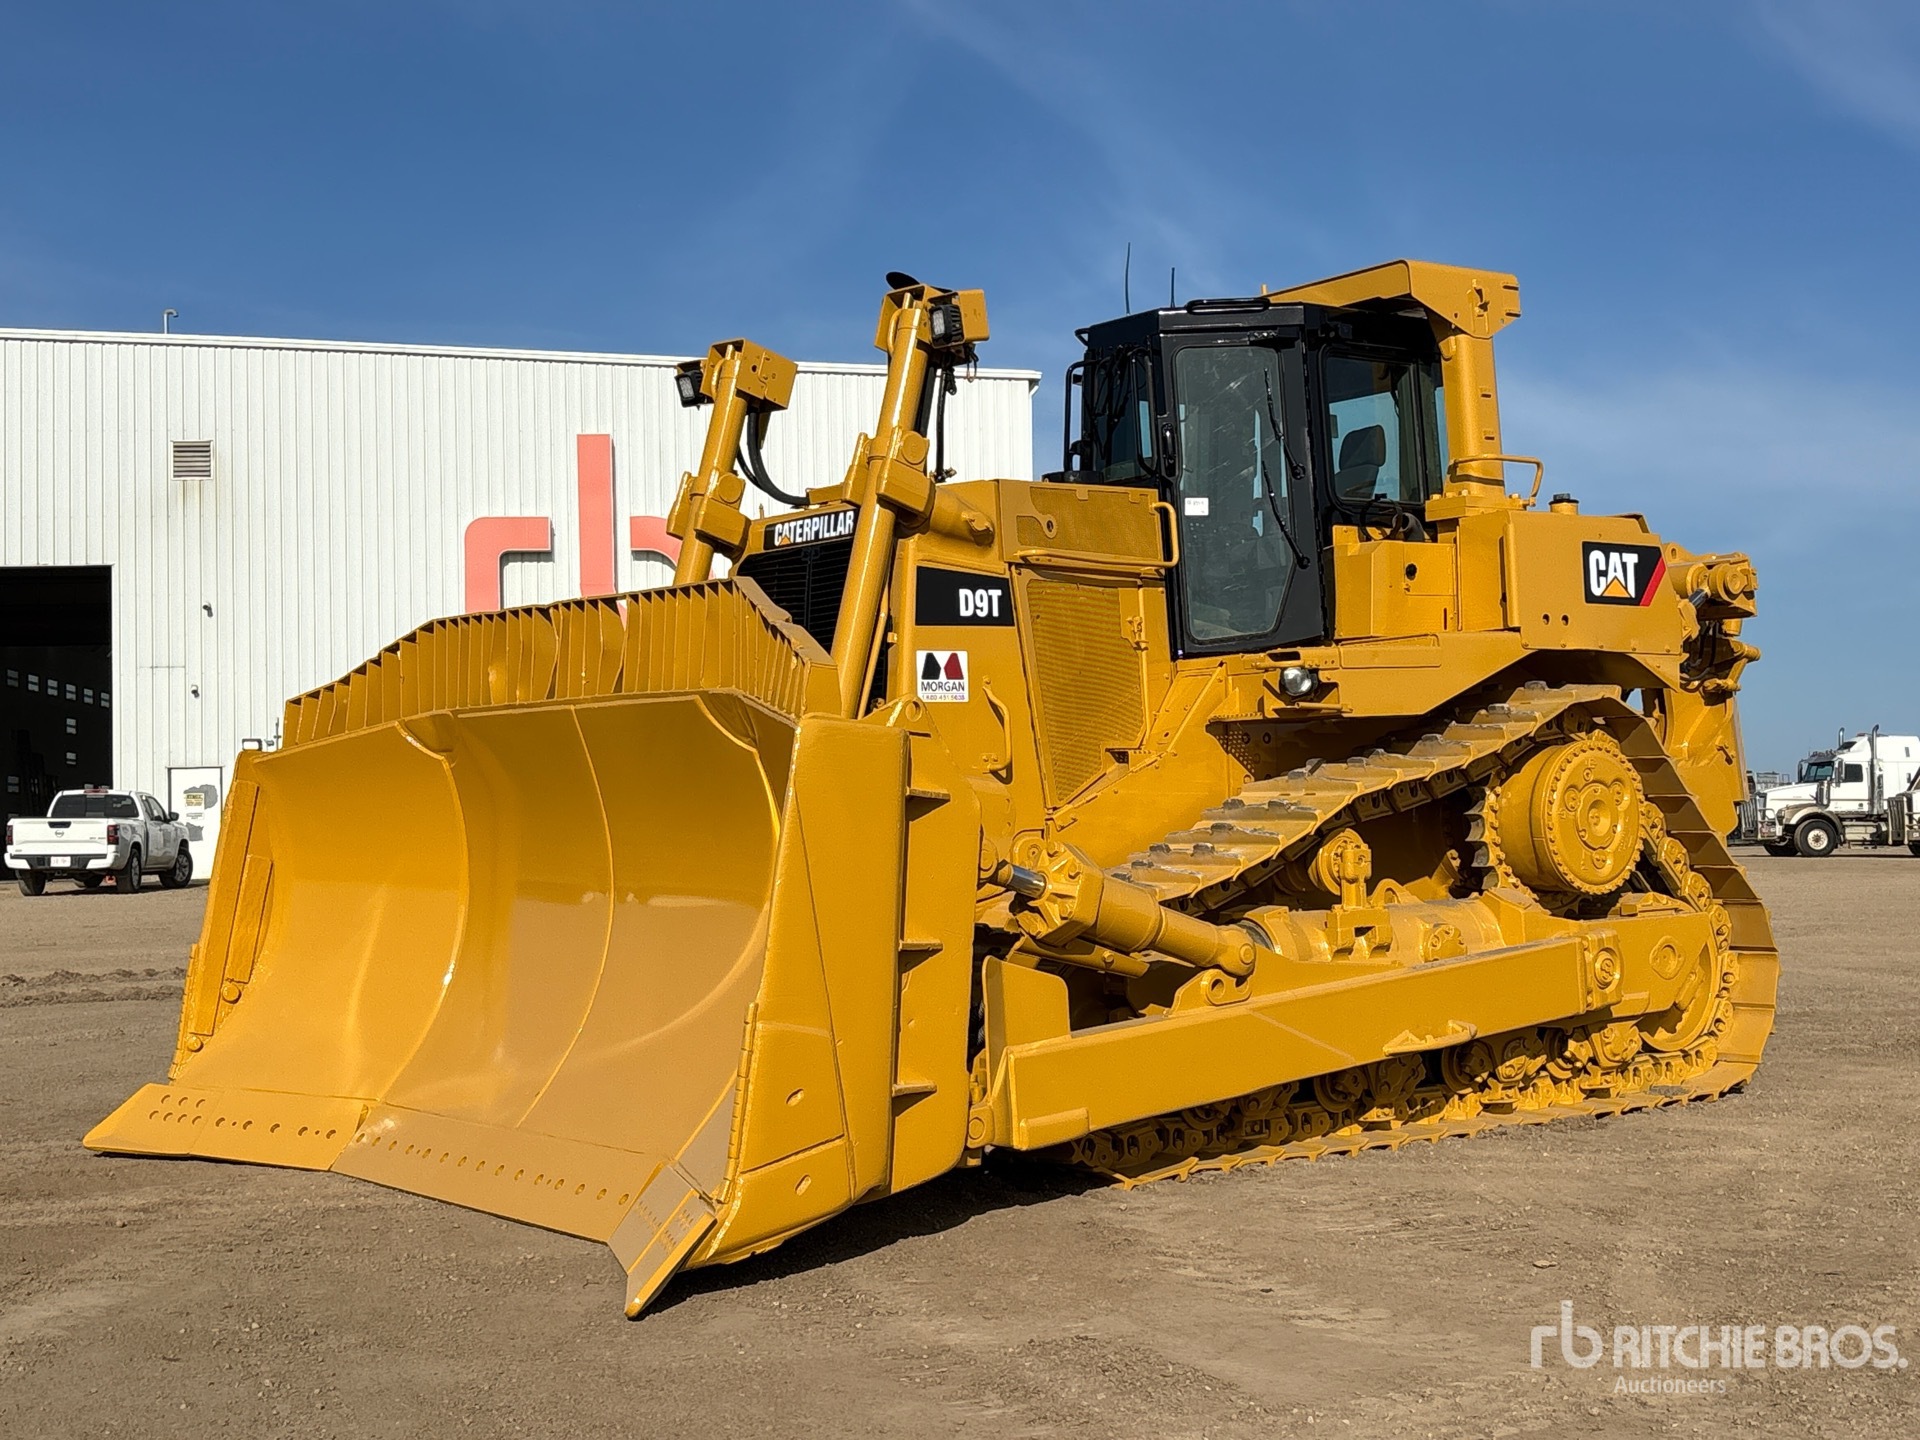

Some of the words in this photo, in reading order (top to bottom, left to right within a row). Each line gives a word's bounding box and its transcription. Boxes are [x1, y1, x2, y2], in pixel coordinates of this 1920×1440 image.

[774, 510, 854, 547] CATERPILLAR
[1589, 550, 1638, 599] CAT
[958, 588, 1002, 617] D9T
[921, 681, 965, 692] MORGAN
